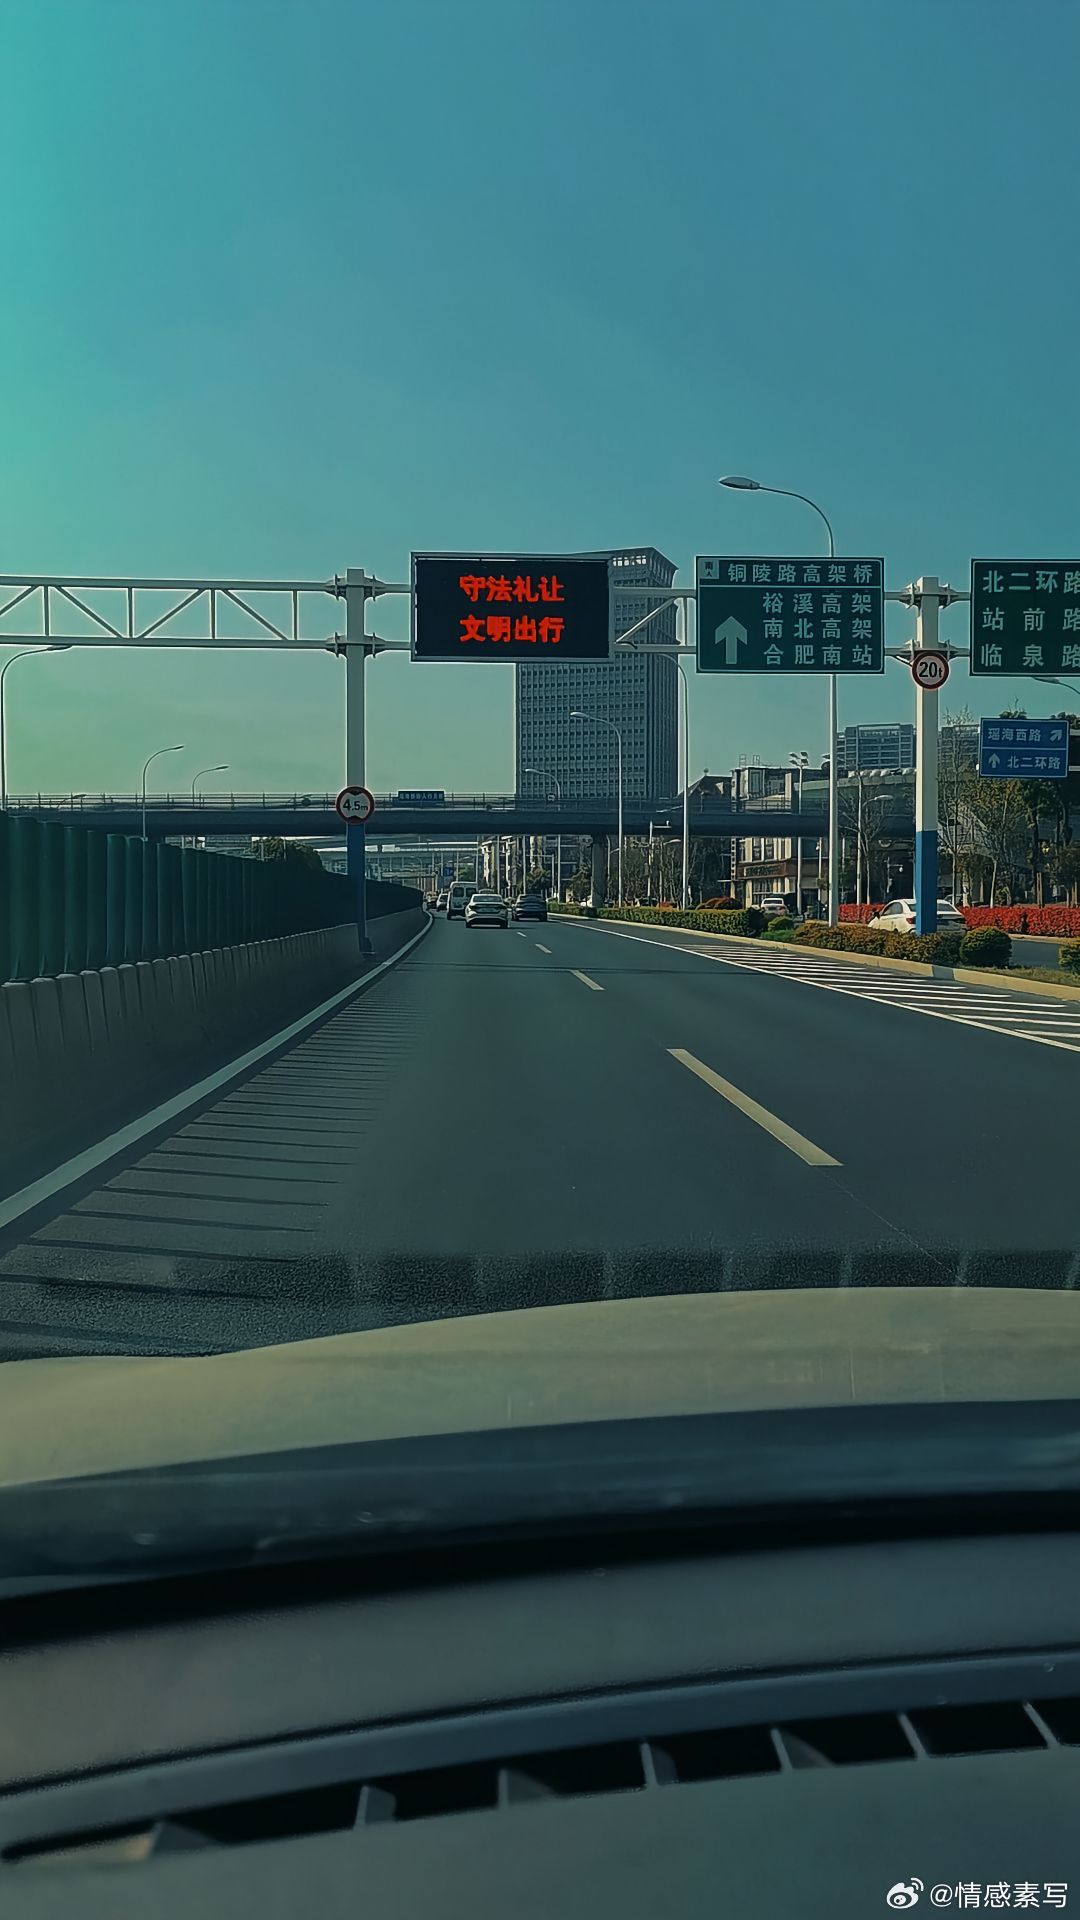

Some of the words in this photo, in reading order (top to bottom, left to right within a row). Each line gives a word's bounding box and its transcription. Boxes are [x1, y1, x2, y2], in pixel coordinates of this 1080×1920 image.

[727, 563, 873, 584] 铜陵路高架桥
[982, 570, 1080, 594] 北二环路
[459, 575, 565, 602] 守法礼让
[762, 592, 873, 614] 裕溪高架
[460, 614, 565, 643] 文明出行
[762, 617, 873, 639] 南北高架
[982, 607, 1080, 631] 站前路
[763, 643, 873, 666] 合肥南站
[981, 643, 1080, 668] 临泉路
[918, 661, 943, 678] 20t
[987, 727, 1042, 742] 瑶海西路
[1007, 755, 1061, 770] 北二环路
[342, 798, 369, 812] 4.5m
